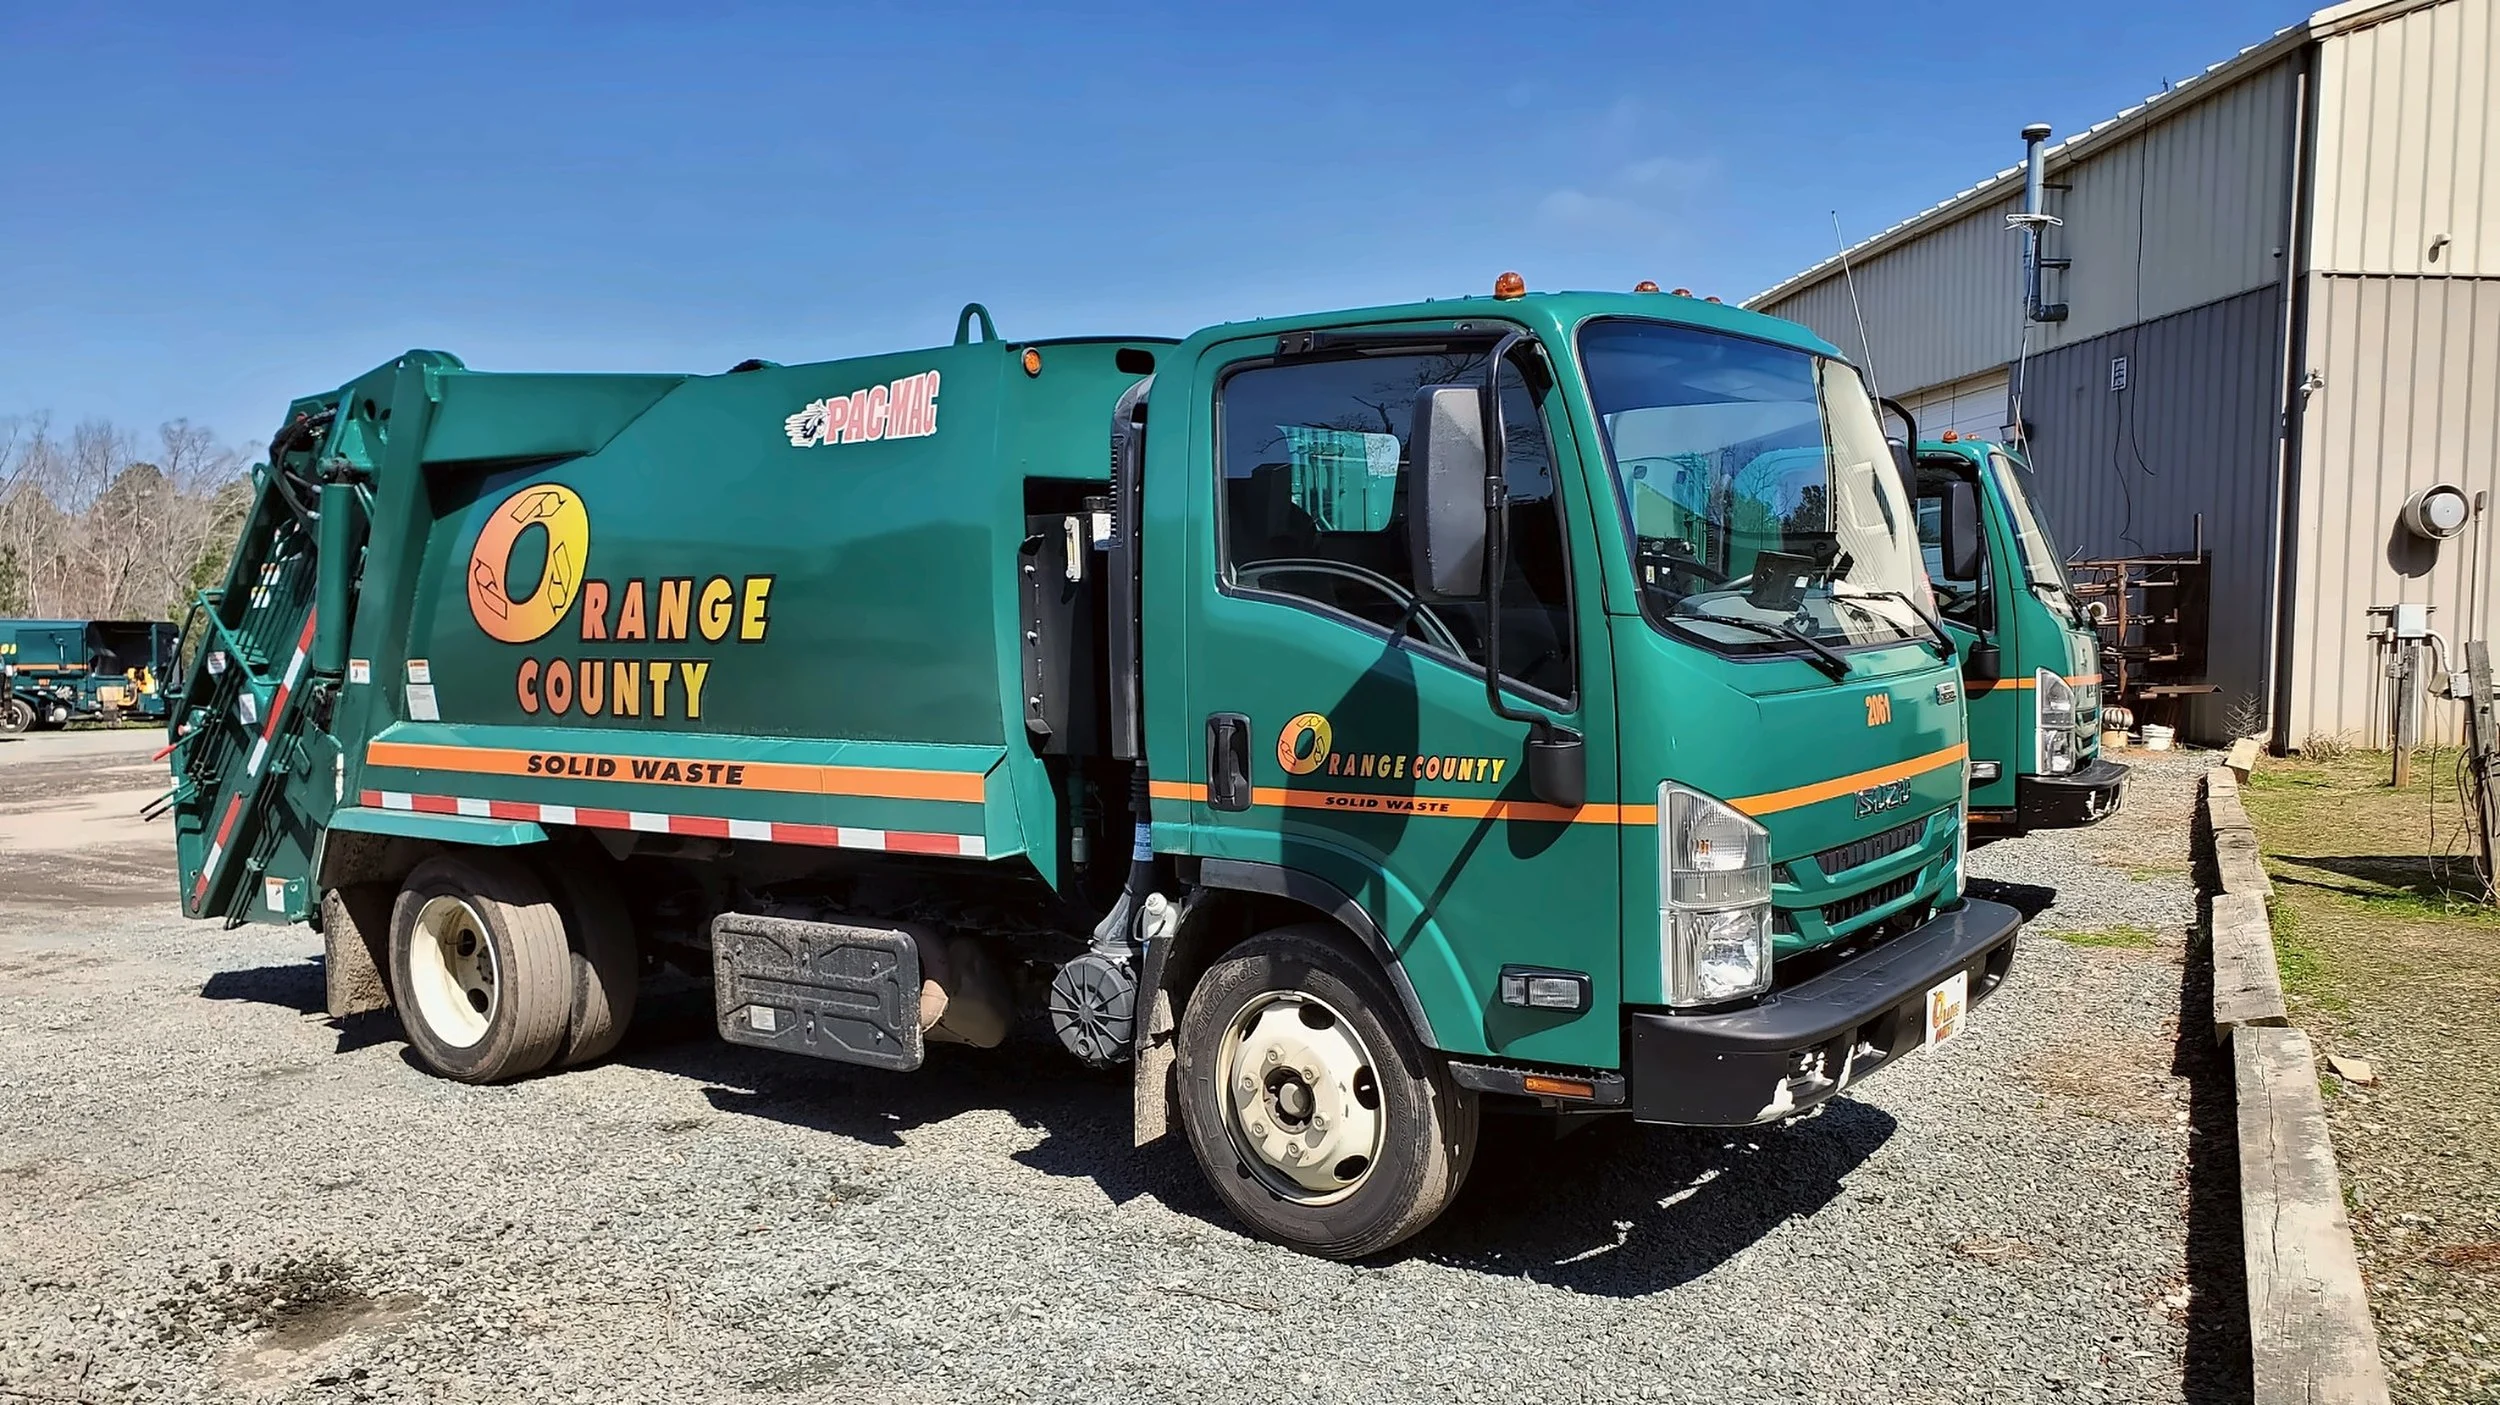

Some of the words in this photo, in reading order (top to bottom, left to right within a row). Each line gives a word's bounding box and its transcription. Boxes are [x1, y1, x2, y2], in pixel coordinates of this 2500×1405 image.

[824, 371, 939, 443] PAC-MAC
[467, 482, 776, 644] ORANGE
[516, 657, 713, 719] COUNTY
[1865, 693, 1892, 727] 2061
[527, 754, 617, 778] SOLID
[631, 759, 745, 785] WASTE
[1276, 711, 1407, 780] ORANGE
[1412, 754, 1506, 784] COUNTY
[1325, 796, 1379, 808] SOLID
[1386, 800, 1451, 812] WASTE
[1855, 776, 1912, 820] ISUZU
